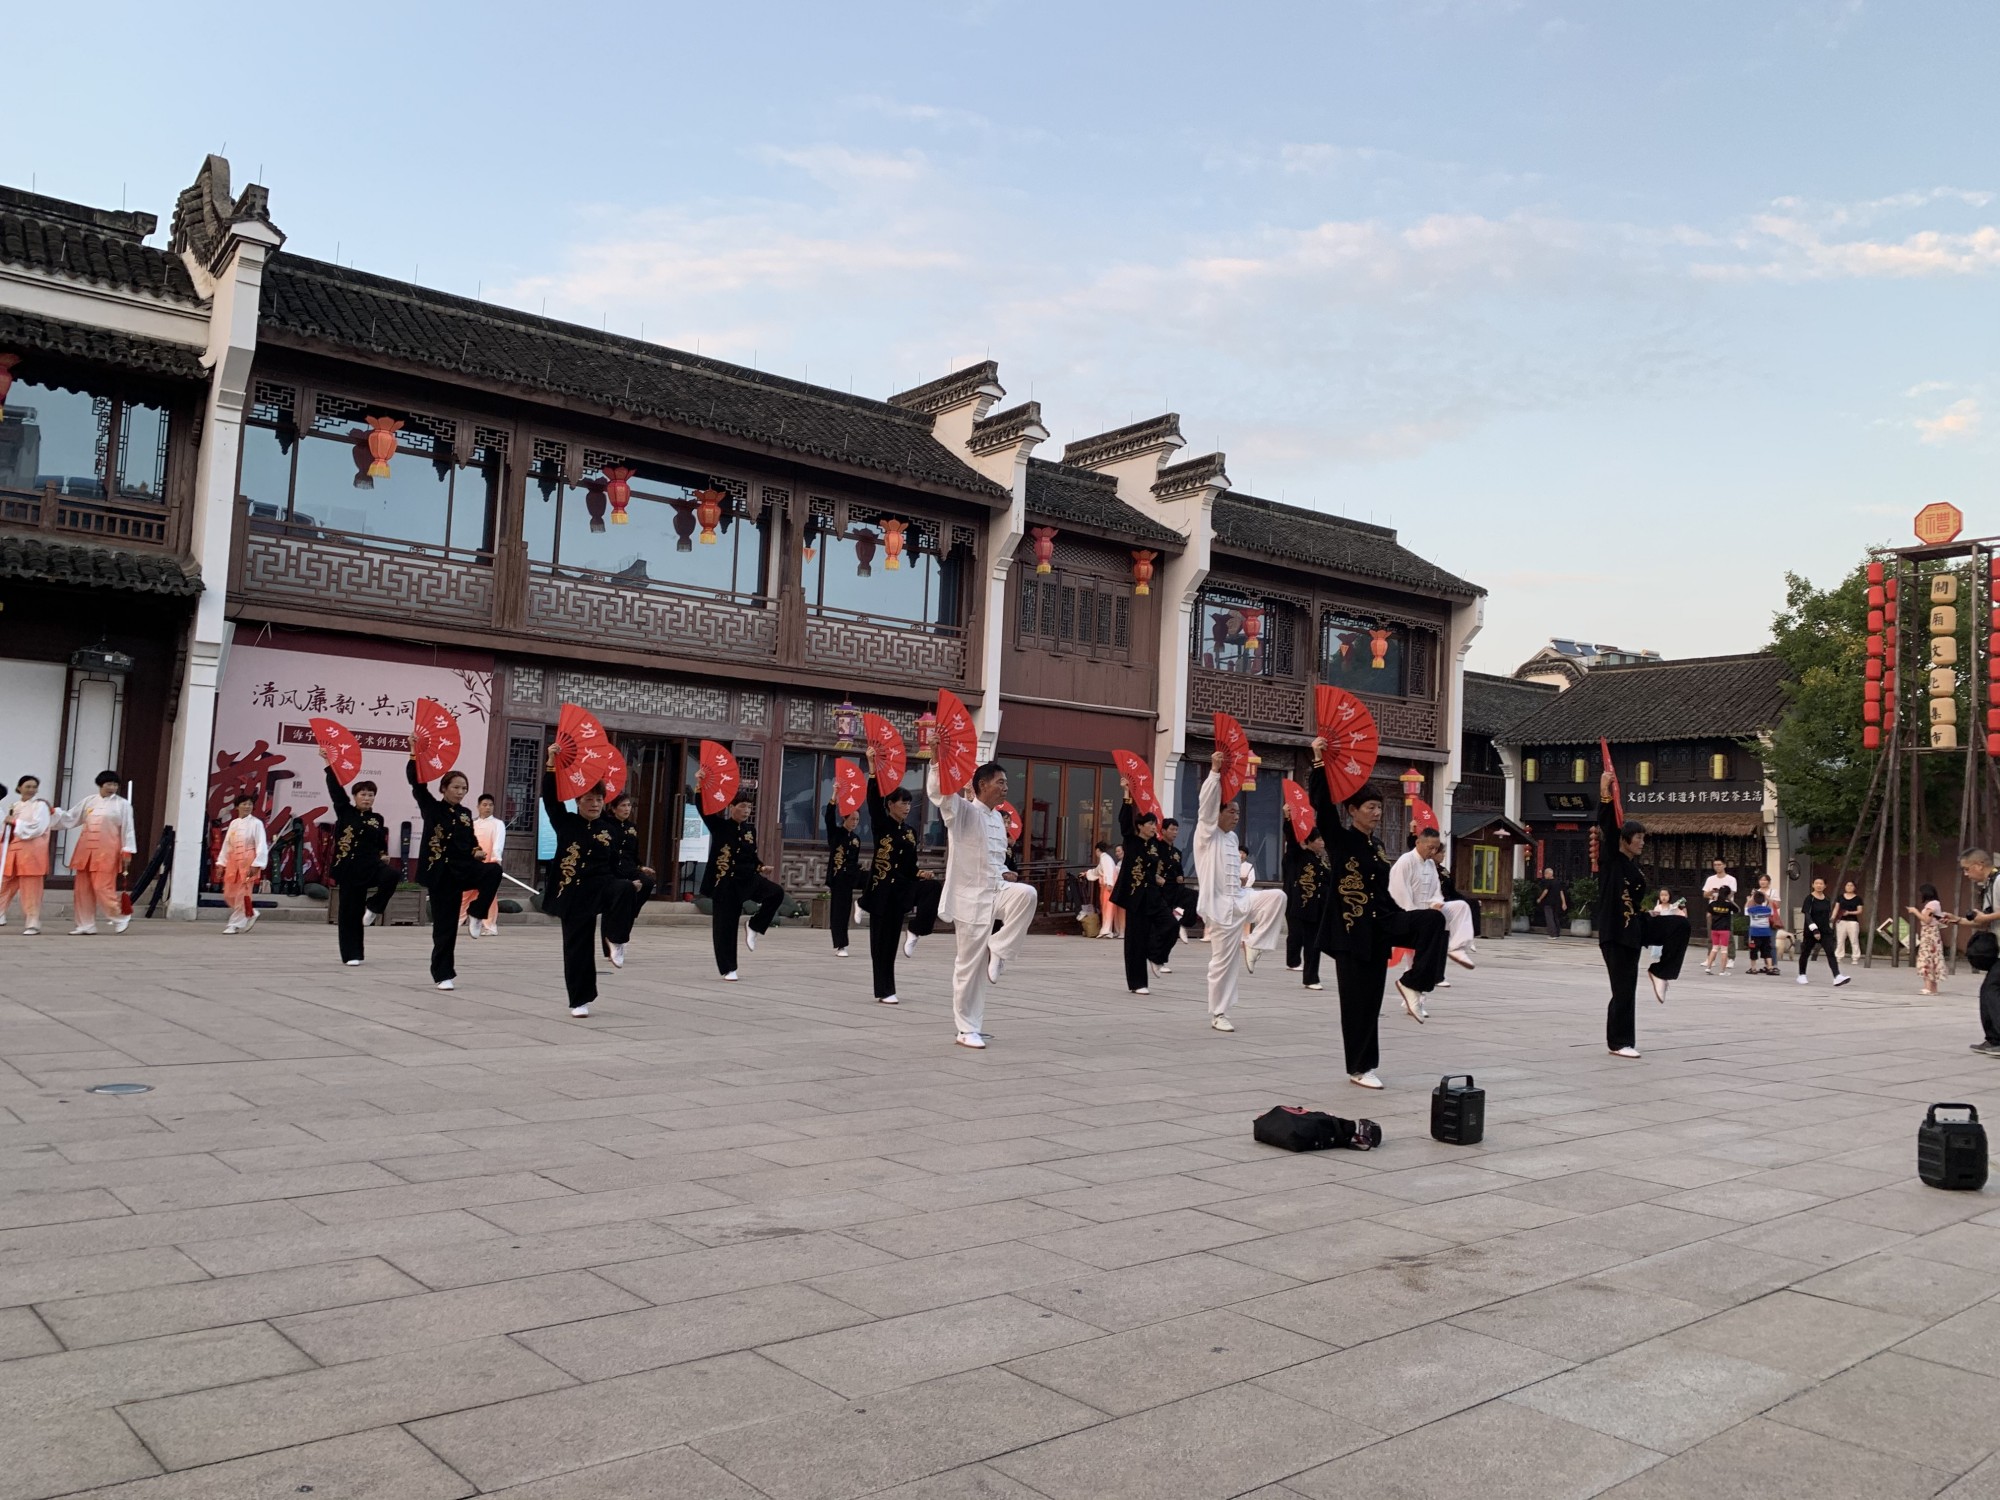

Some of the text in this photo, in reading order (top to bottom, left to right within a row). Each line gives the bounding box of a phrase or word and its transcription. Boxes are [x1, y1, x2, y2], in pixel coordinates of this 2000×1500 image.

[252, 681, 461, 721] 清风廉韵·共同
